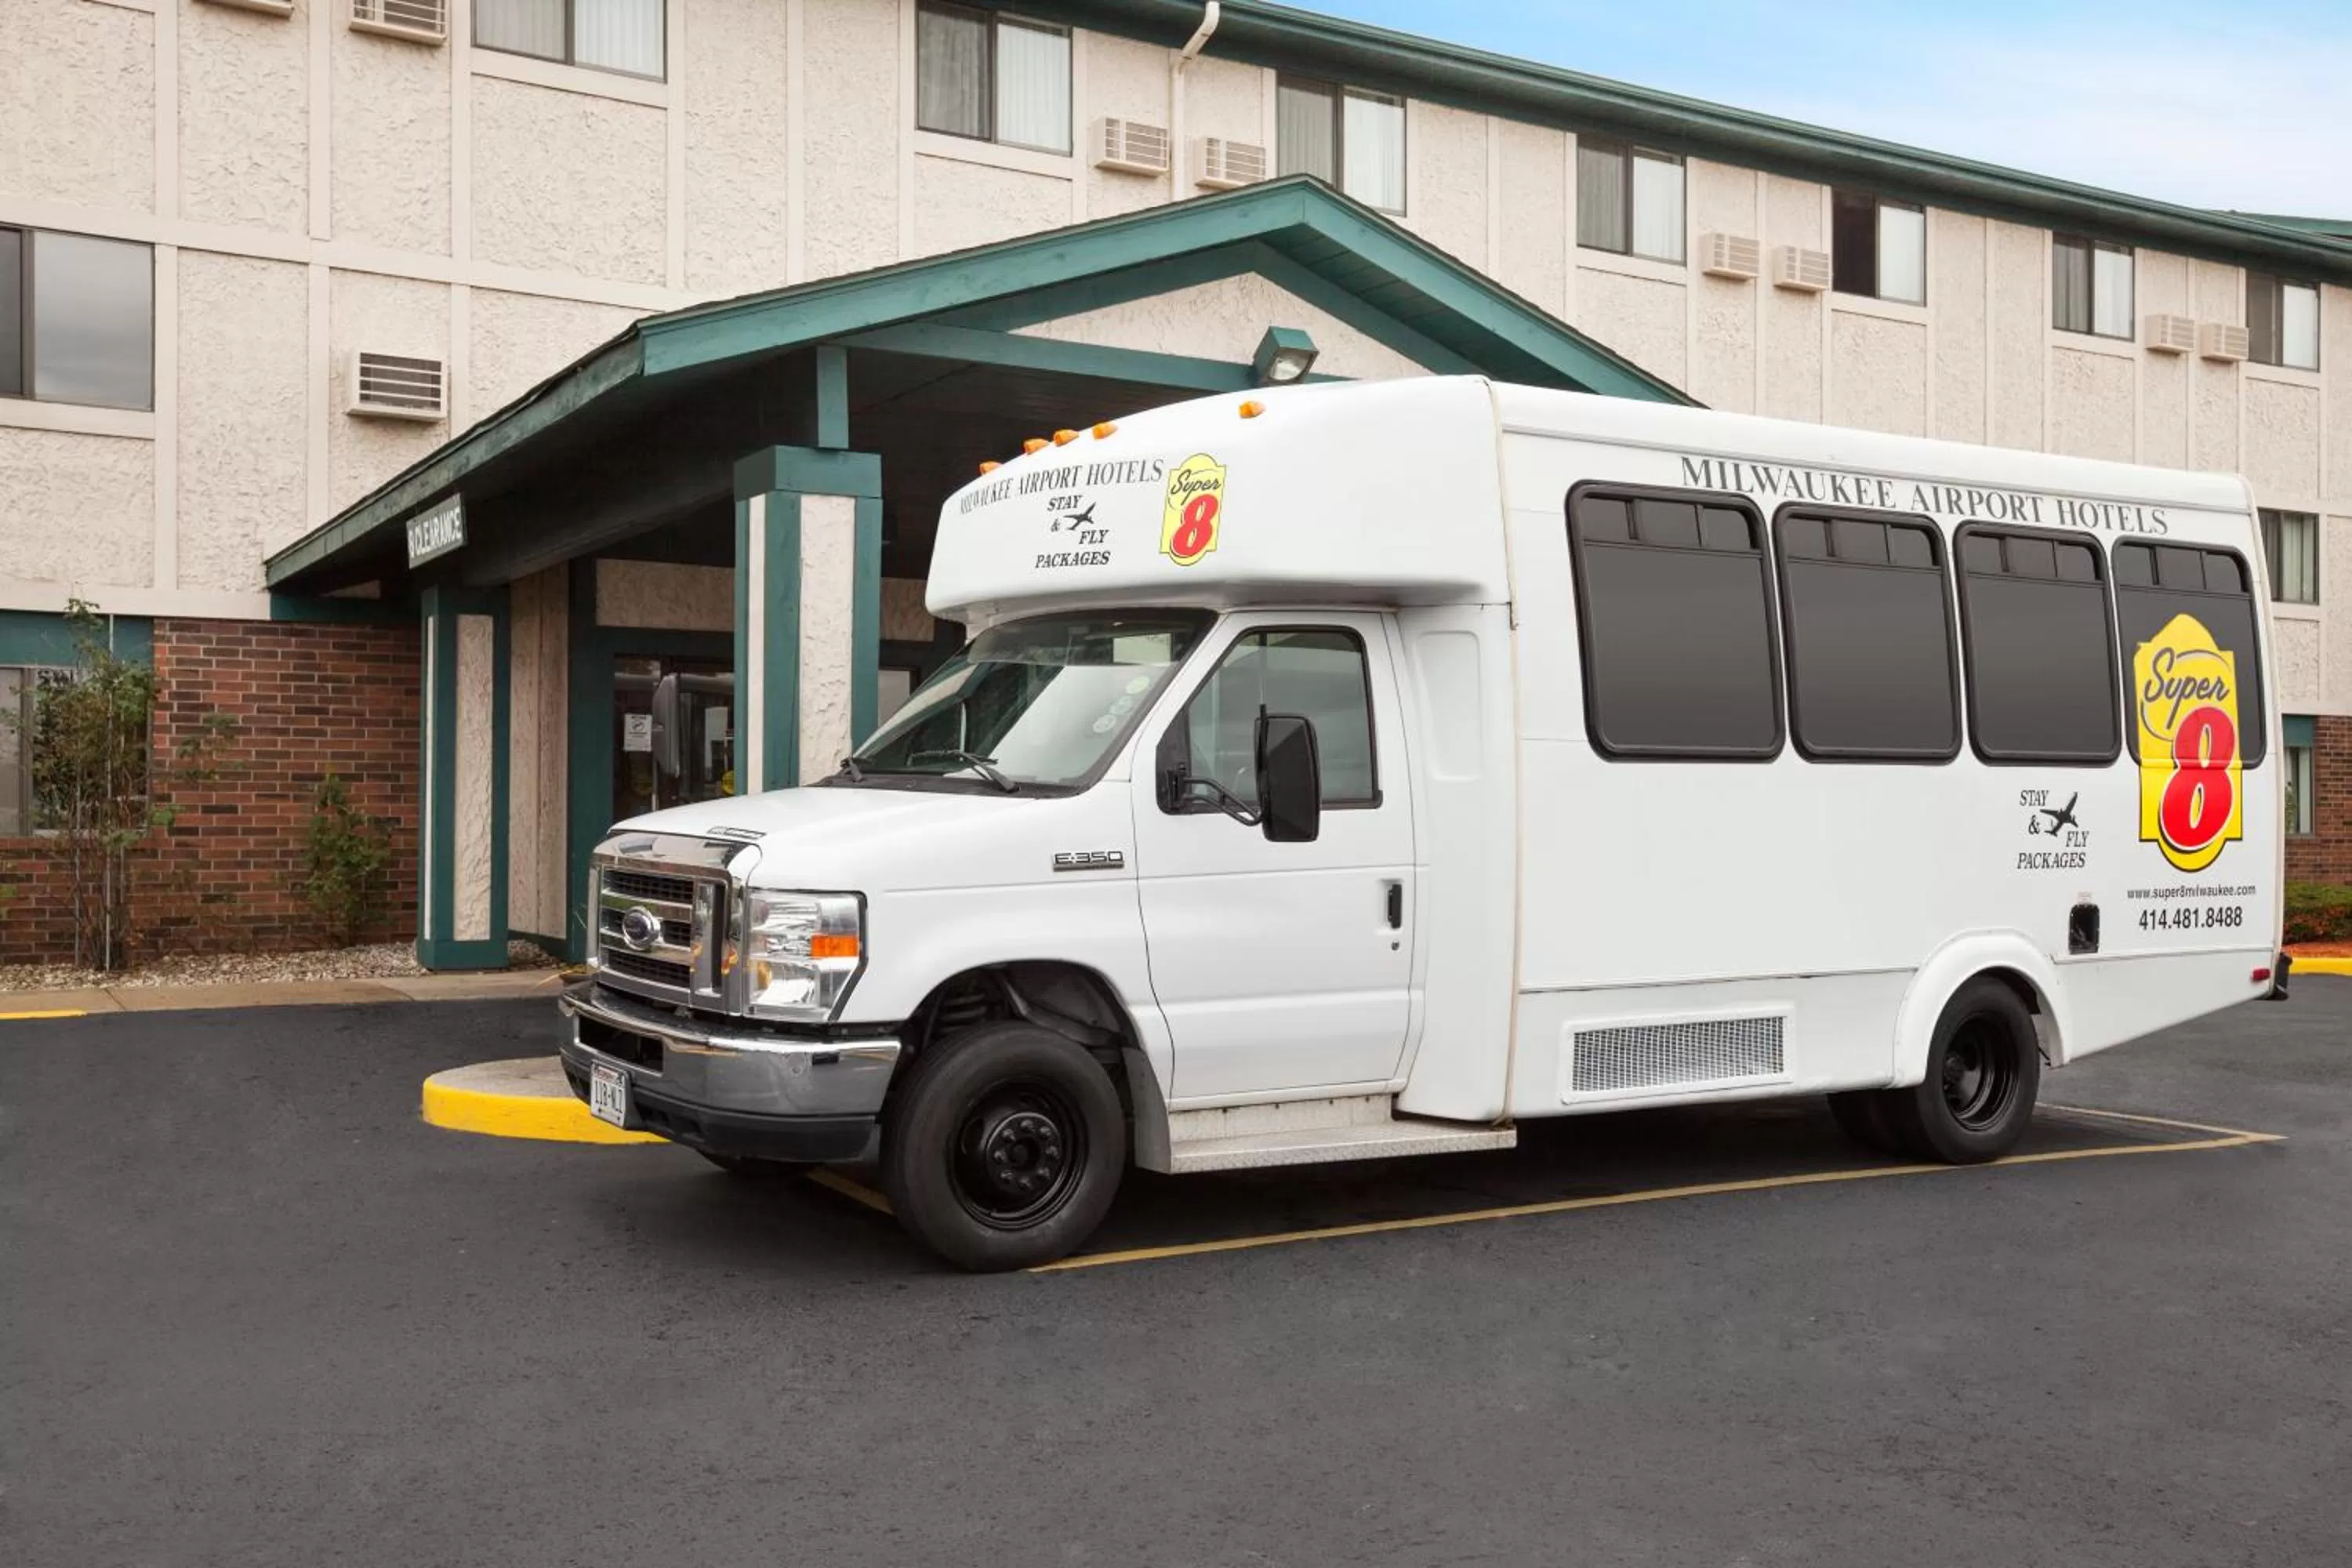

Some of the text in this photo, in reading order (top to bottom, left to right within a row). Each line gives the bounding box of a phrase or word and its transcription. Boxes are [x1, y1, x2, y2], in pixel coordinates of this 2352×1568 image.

[1018, 466, 1082, 495] AIRPORT
[1087, 459, 1164, 485] HOTELS
[1171, 469, 1222, 506] Super
[1681, 456, 2169, 535] MILWAUKEE AIRPORT HOTELS
[1047, 495, 1083, 512] STAY
[1050, 517, 1061, 532] &
[1169, 493, 1219, 558] 8
[1078, 529, 1109, 545] FLY
[1035, 551, 1111, 568] PACKAGES
[2144, 647, 2229, 730] Super
[2158, 706, 2235, 852] 8
[2020, 789, 2049, 807] STAY
[2028, 815, 2040, 835] &
[2066, 830, 2089, 848] FLY
[2017, 852, 2086, 869] PACKAGES
[2127, 884, 2256, 901] www.super8milwaukee.com
[2139, 906, 2243, 931] 414.481.8488
